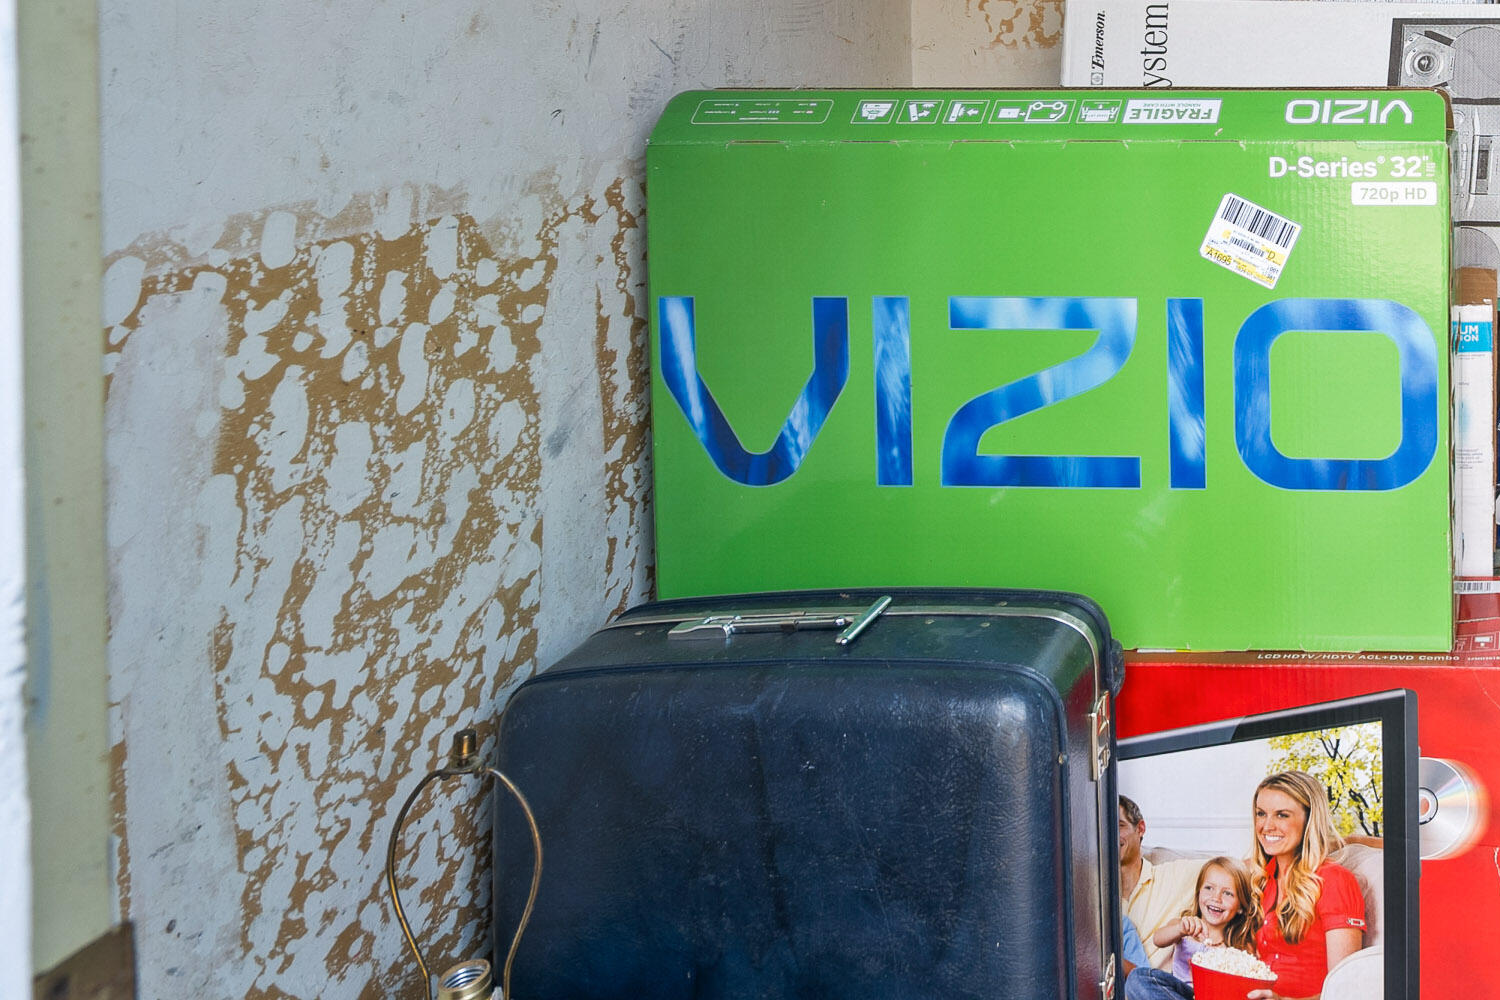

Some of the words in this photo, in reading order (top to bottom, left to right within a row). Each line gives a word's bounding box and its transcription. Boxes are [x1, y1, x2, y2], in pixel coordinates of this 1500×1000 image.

[1140, 3, 1173, 87] ystem
[1129, 109, 1213, 120] FRAGILE
[1285, 99, 1413, 124] VIZIO
[1360, 188, 1399, 202] 720p
[1405, 188, 1427, 200] HD
[658, 296, 1439, 491] VIZIO
[1283, 653, 1355, 661] HDTV/HDTV
